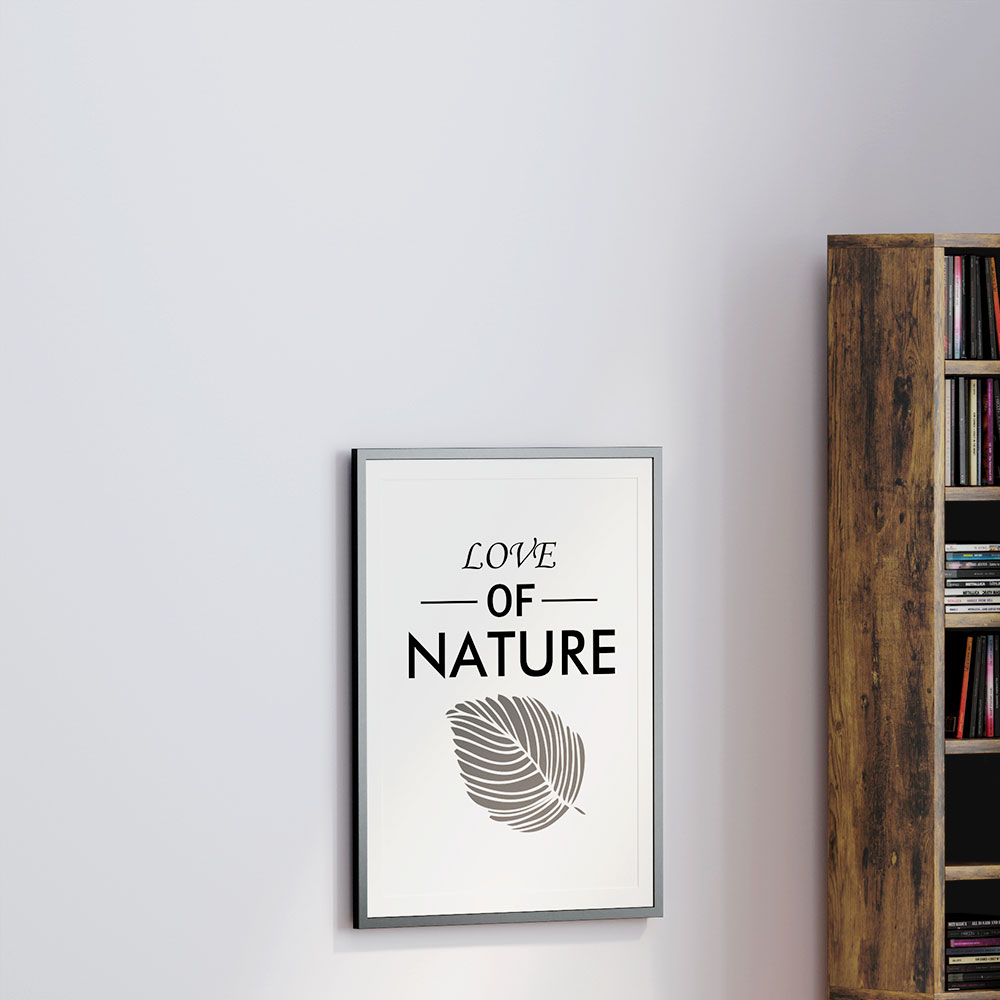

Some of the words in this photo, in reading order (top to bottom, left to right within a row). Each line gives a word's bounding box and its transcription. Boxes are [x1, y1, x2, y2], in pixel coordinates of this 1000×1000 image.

[461, 538, 557, 569] LOVE
[487, 584, 535, 618] OF
[408, 629, 616, 679] NATURE
